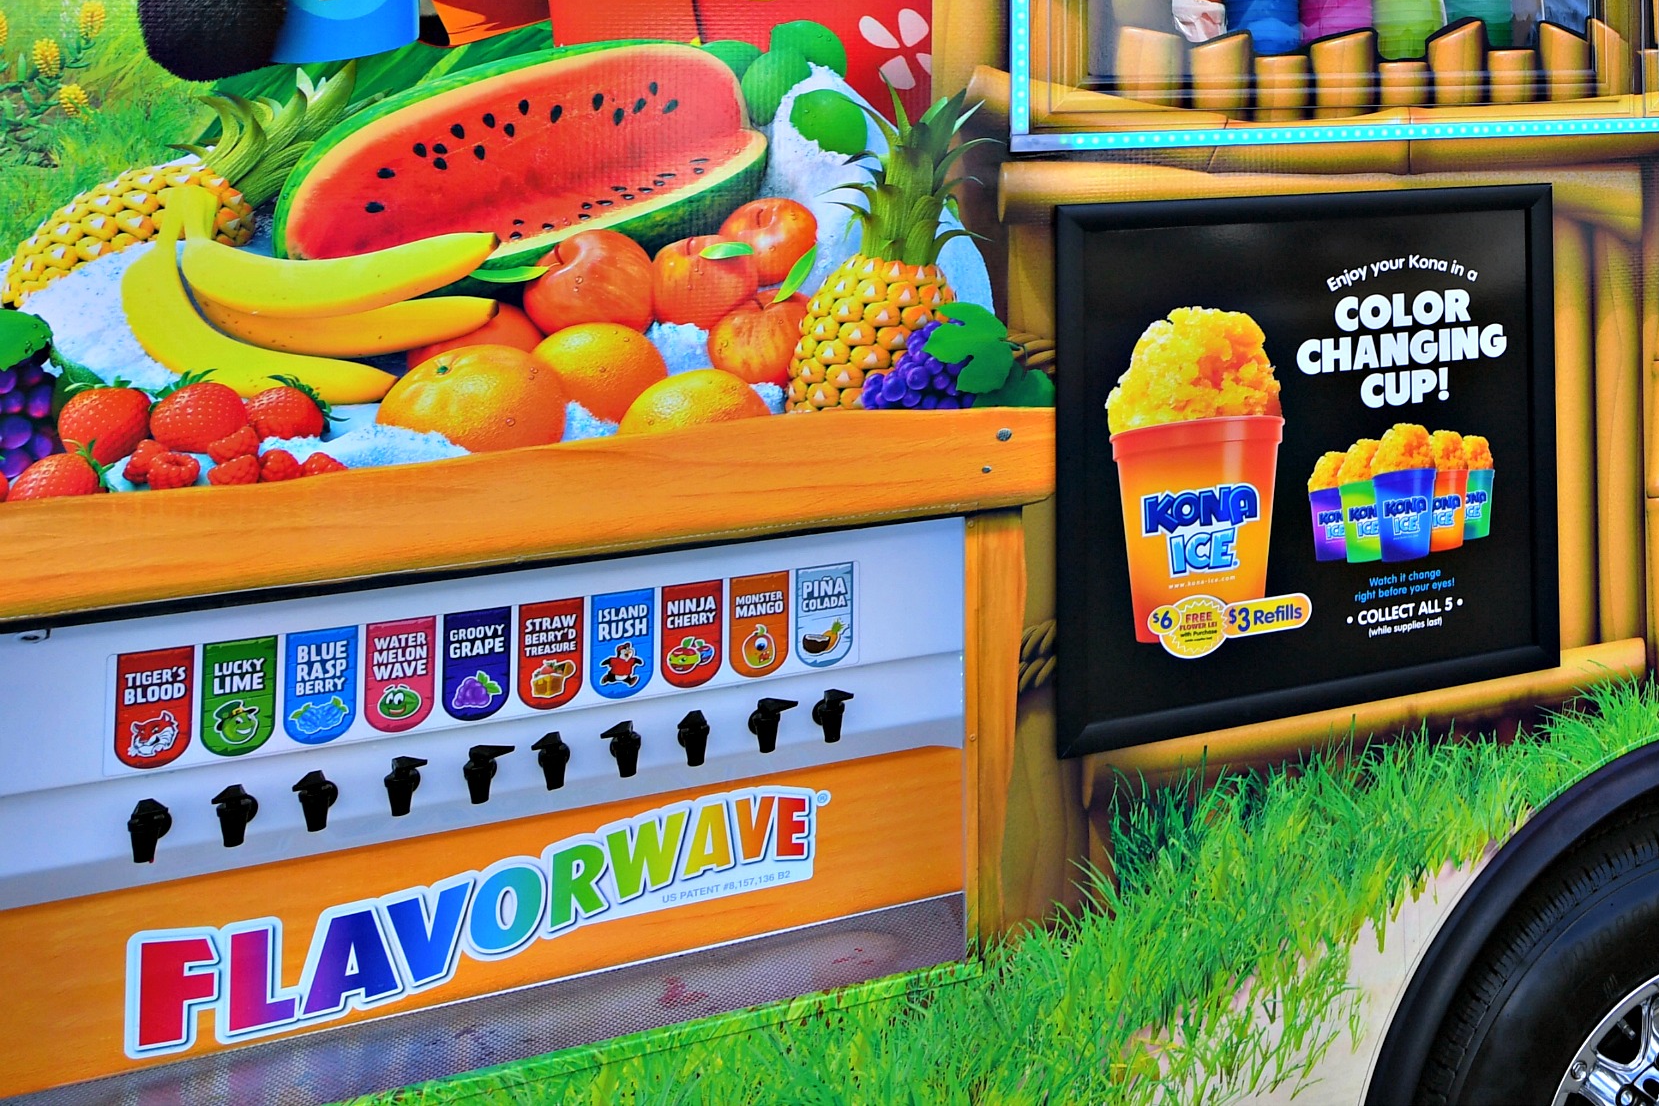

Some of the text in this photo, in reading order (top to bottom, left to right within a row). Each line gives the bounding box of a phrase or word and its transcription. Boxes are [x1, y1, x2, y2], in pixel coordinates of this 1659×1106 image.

[1326, 255, 1478, 292] Enjoy your Kona in a
[1335, 288, 1471, 332] COLOR
[1296, 323, 1507, 375] CHANGING
[1360, 367, 1449, 408] CUP!
[1142, 484, 1259, 535] KONA
[1383, 497, 1427, 517] KONA
[1394, 515, 1419, 534] ICE
[802, 577, 846, 596] PIÑA
[1369, 569, 1441, 587] Watch it change
[735, 591, 783, 606] MONSTER
[1354, 578, 1455, 603] right before your eyes!
[666, 596, 716, 615] NINJA
[735, 601, 784, 619] MANGO
[802, 594, 846, 612] COLADA
[1358, 597, 1453, 625] COLLECT ALL 5
[524, 613, 577, 633] STRAW
[597, 604, 648, 623] ISLAND
[666, 610, 716, 629] CHERRY
[1153, 610, 1173, 629] $6
[1185, 612, 1212, 622] FREE
[1228, 604, 1302, 632] $3 Refills
[449, 624, 505, 642] GROOVY
[525, 626, 577, 646] BERRY'D
[597, 618, 648, 641] RUSH
[1368, 616, 1442, 638] (while supplies last)
[373, 632, 427, 649] WATER
[449, 637, 505, 659] GRAPE
[524, 641, 577, 657] TREASURE
[296, 640, 347, 663] BLUE
[372, 646, 428, 666] MELON
[125, 666, 186, 687] TIGER'S
[214, 658, 264, 676] LUCKY
[296, 660, 347, 681] RASP
[372, 659, 427, 680] WAVE
[124, 682, 186, 706] BLOOD
[213, 676, 264, 696] LIME
[295, 677, 345, 697] BERRY
[662, 894, 677, 903] US
[680, 885, 721, 900] PATENT
[778, 871, 791, 880] B2
[133, 792, 811, 1054] FLAVORWAVE
